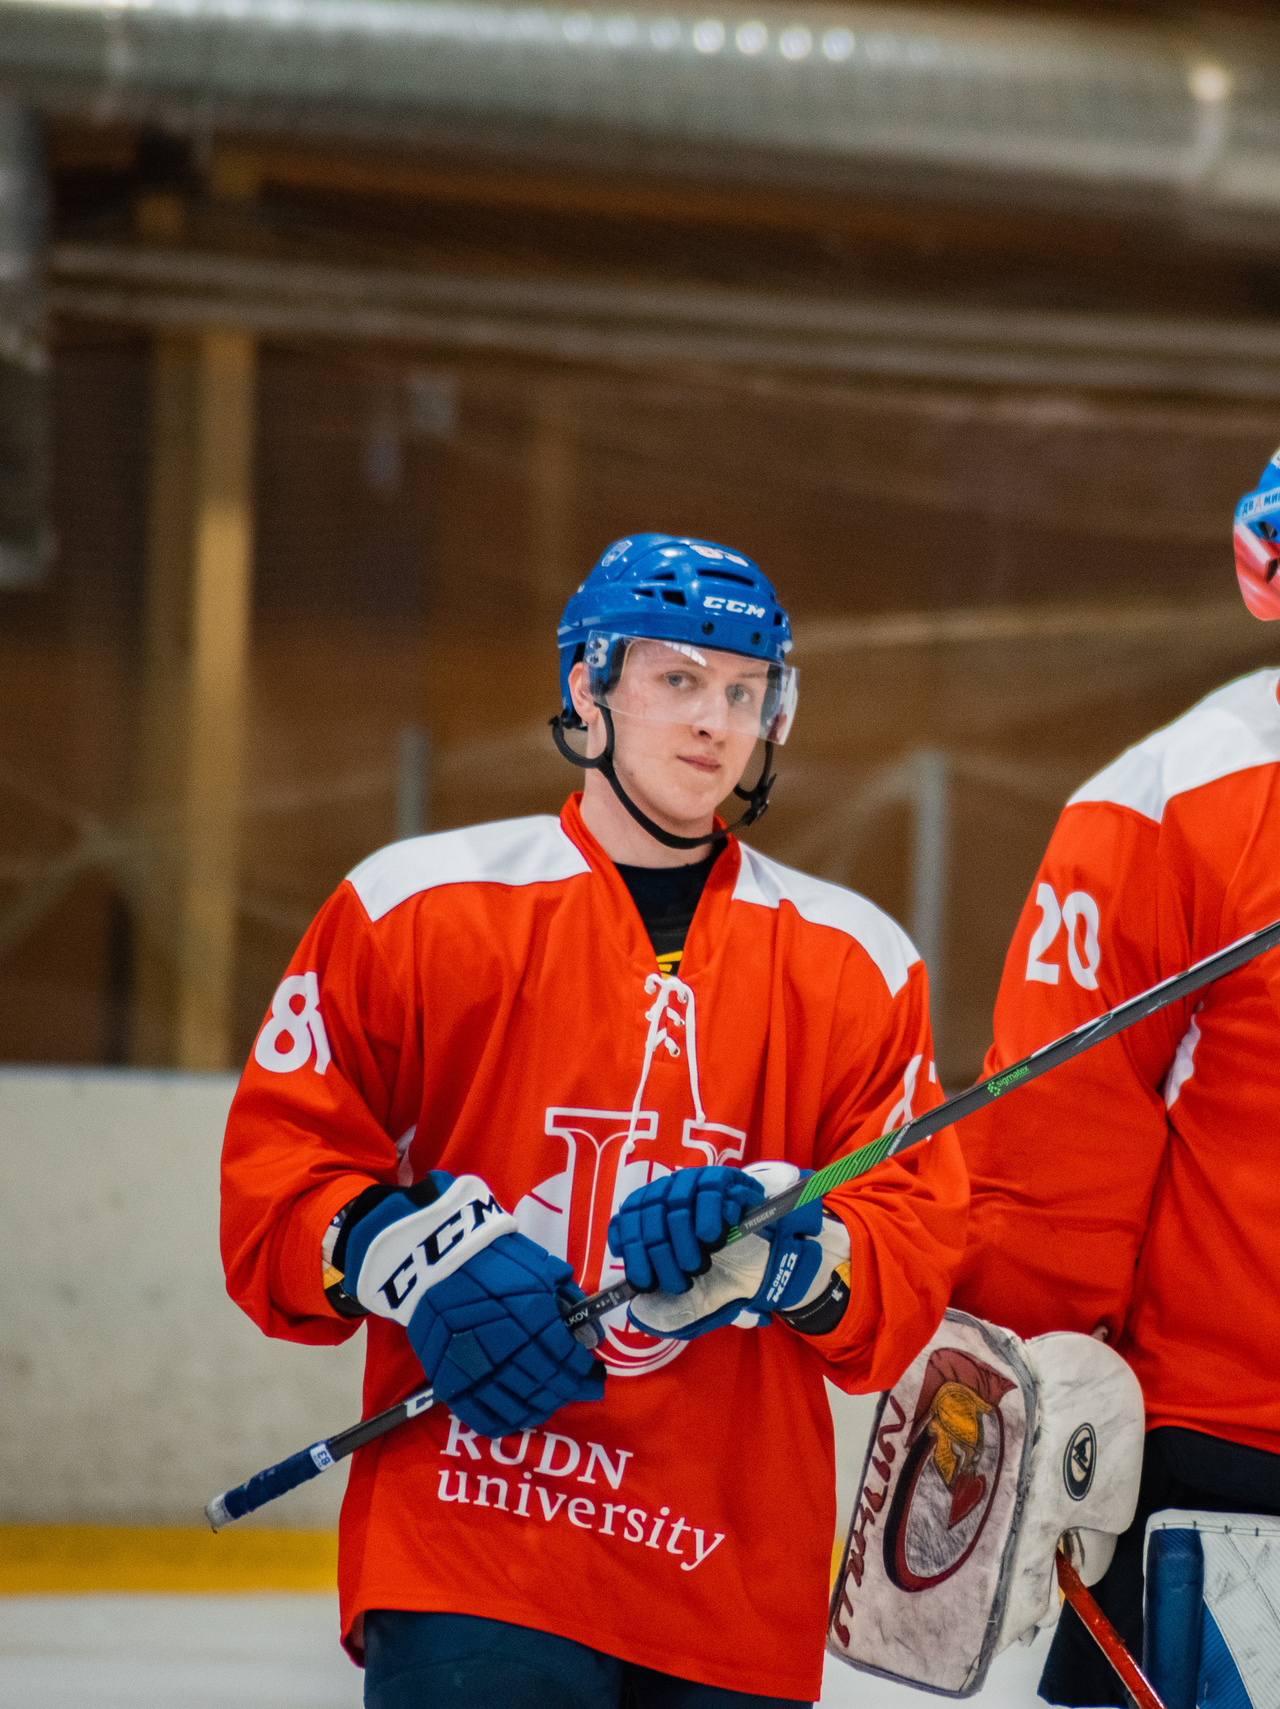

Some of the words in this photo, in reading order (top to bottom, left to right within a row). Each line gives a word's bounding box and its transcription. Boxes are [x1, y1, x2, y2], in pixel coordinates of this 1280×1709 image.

[703, 595, 766, 619] CCM
[1025, 881, 1101, 991] 20
[376, 1194, 503, 1311] CCM
[772, 1251, 798, 1303] CCM
[440, 1413, 634, 1491] RUDN
[436, 1468, 726, 1572] university
